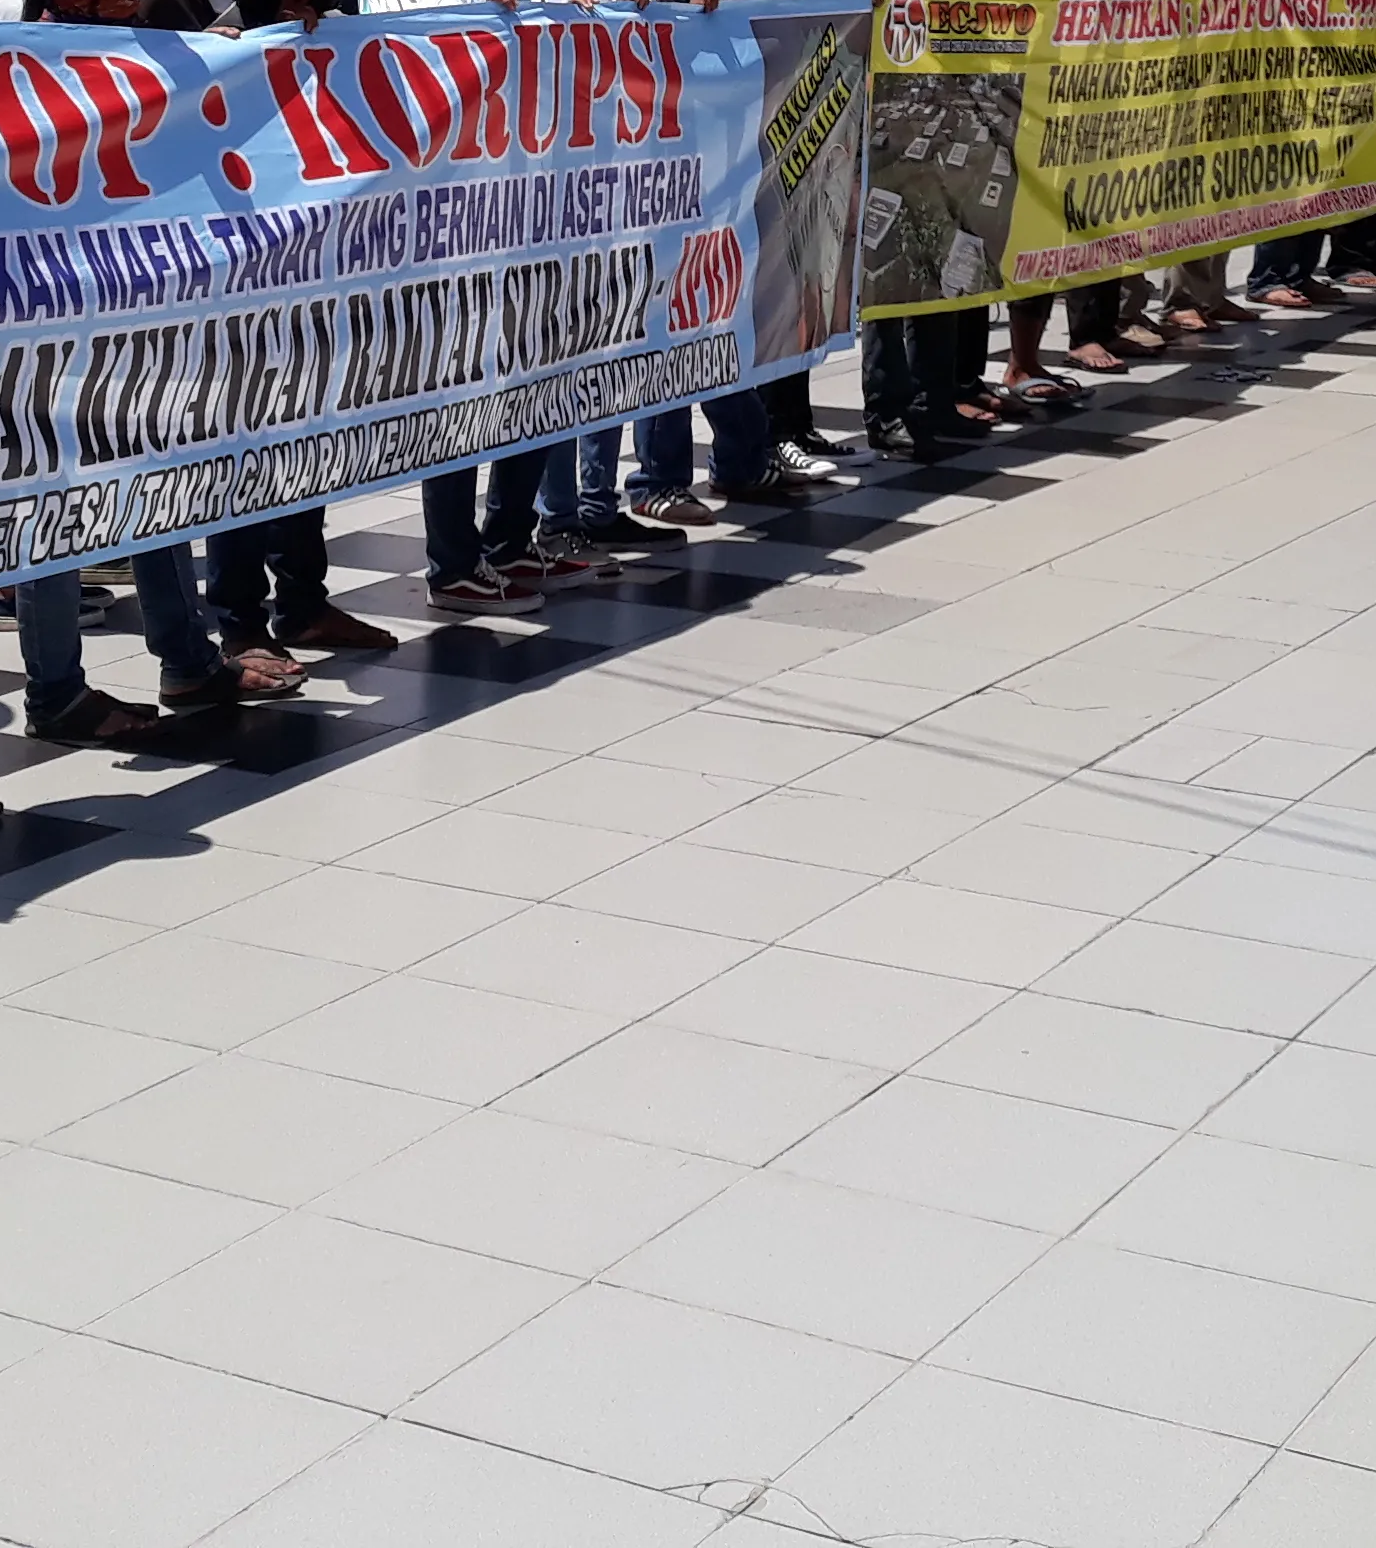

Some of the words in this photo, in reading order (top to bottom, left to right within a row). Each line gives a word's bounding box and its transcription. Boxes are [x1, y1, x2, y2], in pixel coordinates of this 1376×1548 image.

[765, 21, 837, 160] REVOLUSI
[927, 1, 1037, 36] ECJWO
[1048, 63, 1103, 103] TANAH
[1101, 61, 1133, 99] KAS
[1133, 58, 1164, 97] DESA
[264, 20, 684, 181] KORUPSI
[778, 68, 852, 201] AGRARIA
[79, 218, 212, 312] MAFIA
[207, 204, 331, 295] TANAH
[335, 192, 407, 276] YANG
[413, 177, 526, 264] BERMAIN
[532, 172, 556, 244] DI
[560, 166, 619, 239] ASET
[624, 156, 703, 229] NEGARA
[76, 297, 338, 466] KEUANGAN
[337, 271, 494, 410] RAKYAT
[497, 242, 655, 378] SURABAYA
[668, 226, 744, 333] APBD
[32, 478, 120, 563] DESA
[132, 456, 236, 541] TANAH
[231, 423, 368, 518] GANJARAN
[360, 396, 487, 483] KELURAHAN
[483, 370, 575, 449] MEDOKAN
[573, 347, 664, 426] SEMAMPIR
[661, 330, 741, 402] SURABAYA
